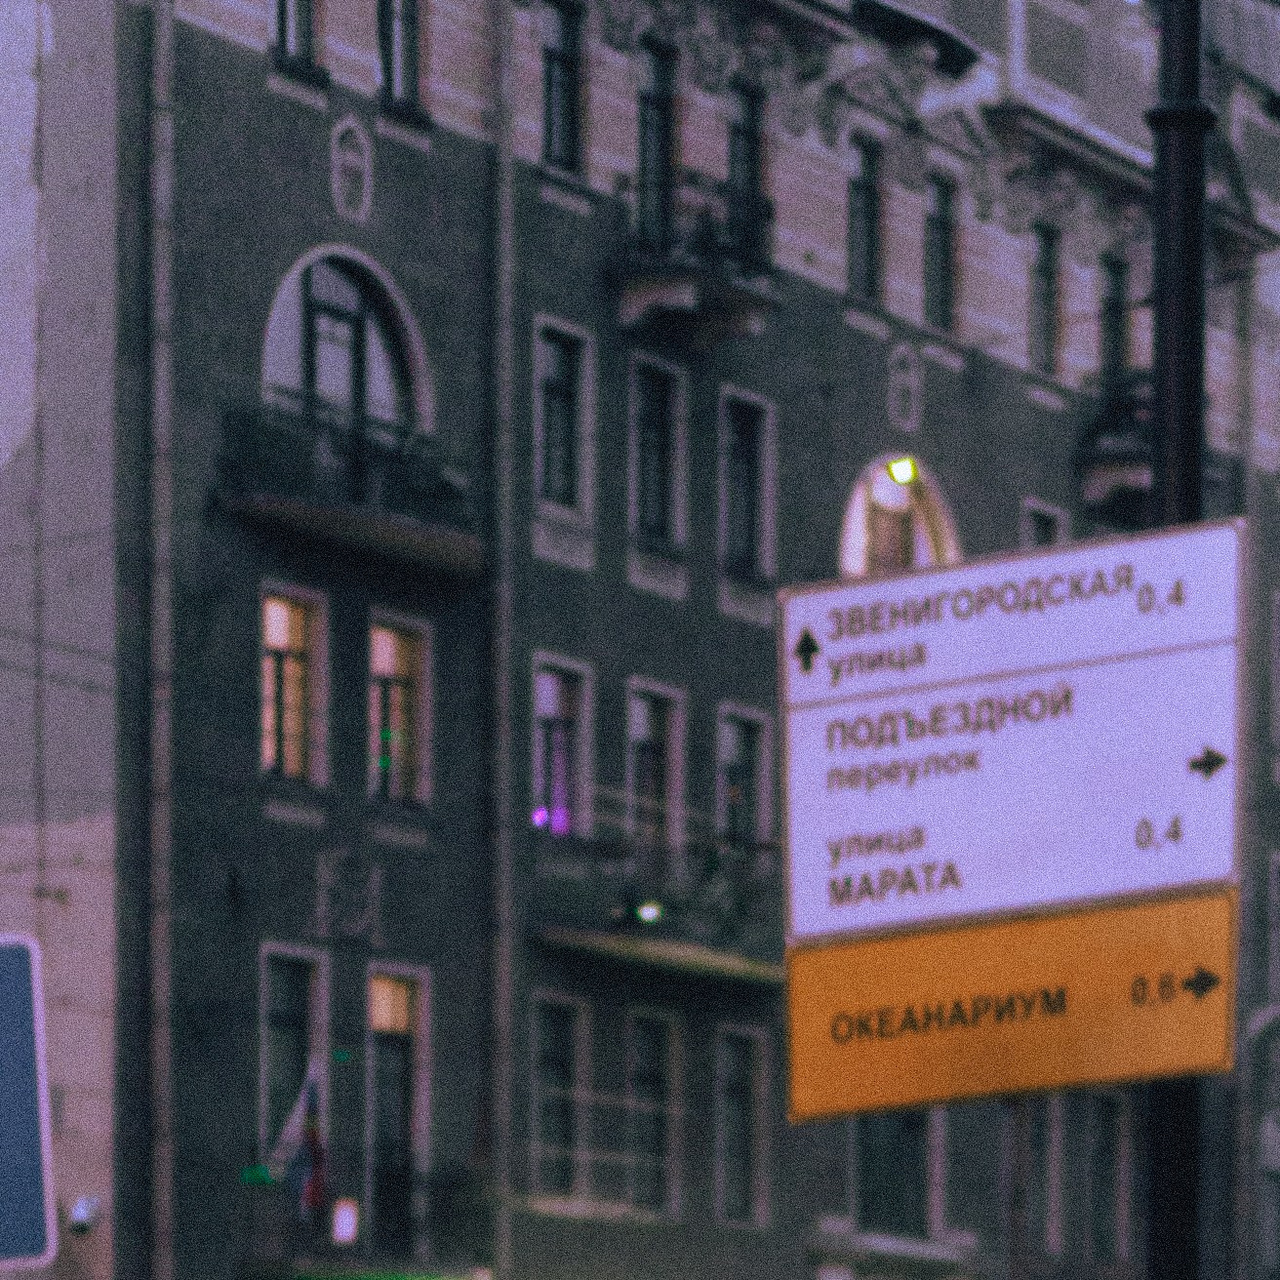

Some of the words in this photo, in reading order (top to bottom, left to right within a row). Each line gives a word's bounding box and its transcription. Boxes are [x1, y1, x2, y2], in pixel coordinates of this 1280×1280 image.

[825, 564, 1136, 642] ЗВЕНИГОРОДСКАЯ
[826, 641, 928, 688] улица
[825, 681, 1074, 752] ПОДЪЕЗДНОЙ
[826, 748, 982, 793] переулок
[827, 826, 928, 863] улица
[828, 861, 962, 905] МАРАТА
[829, 987, 1069, 1046] ОКЕАНАРИУМ
